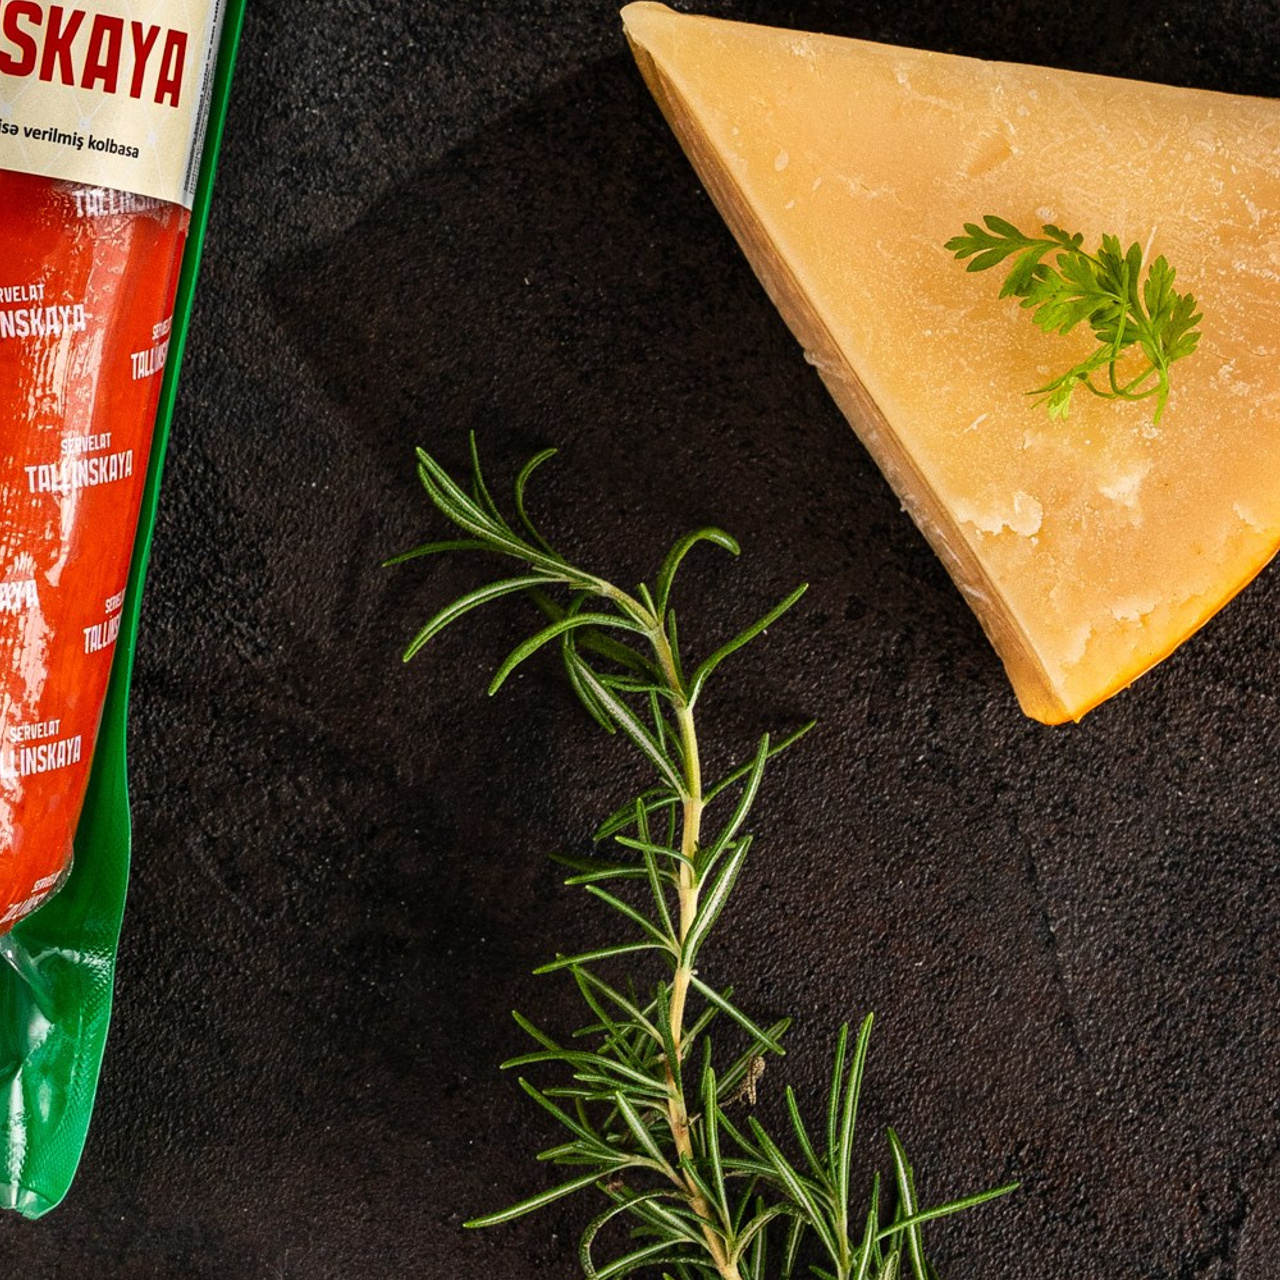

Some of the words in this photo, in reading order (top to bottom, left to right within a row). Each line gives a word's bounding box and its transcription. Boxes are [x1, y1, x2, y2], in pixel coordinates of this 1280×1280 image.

[24, 126, 84, 150] verilmiş
[88, 135, 139, 158] kolbasa
[61, 433, 112, 454] SERVELAT
[10, 719, 60, 743] SERVELAT
